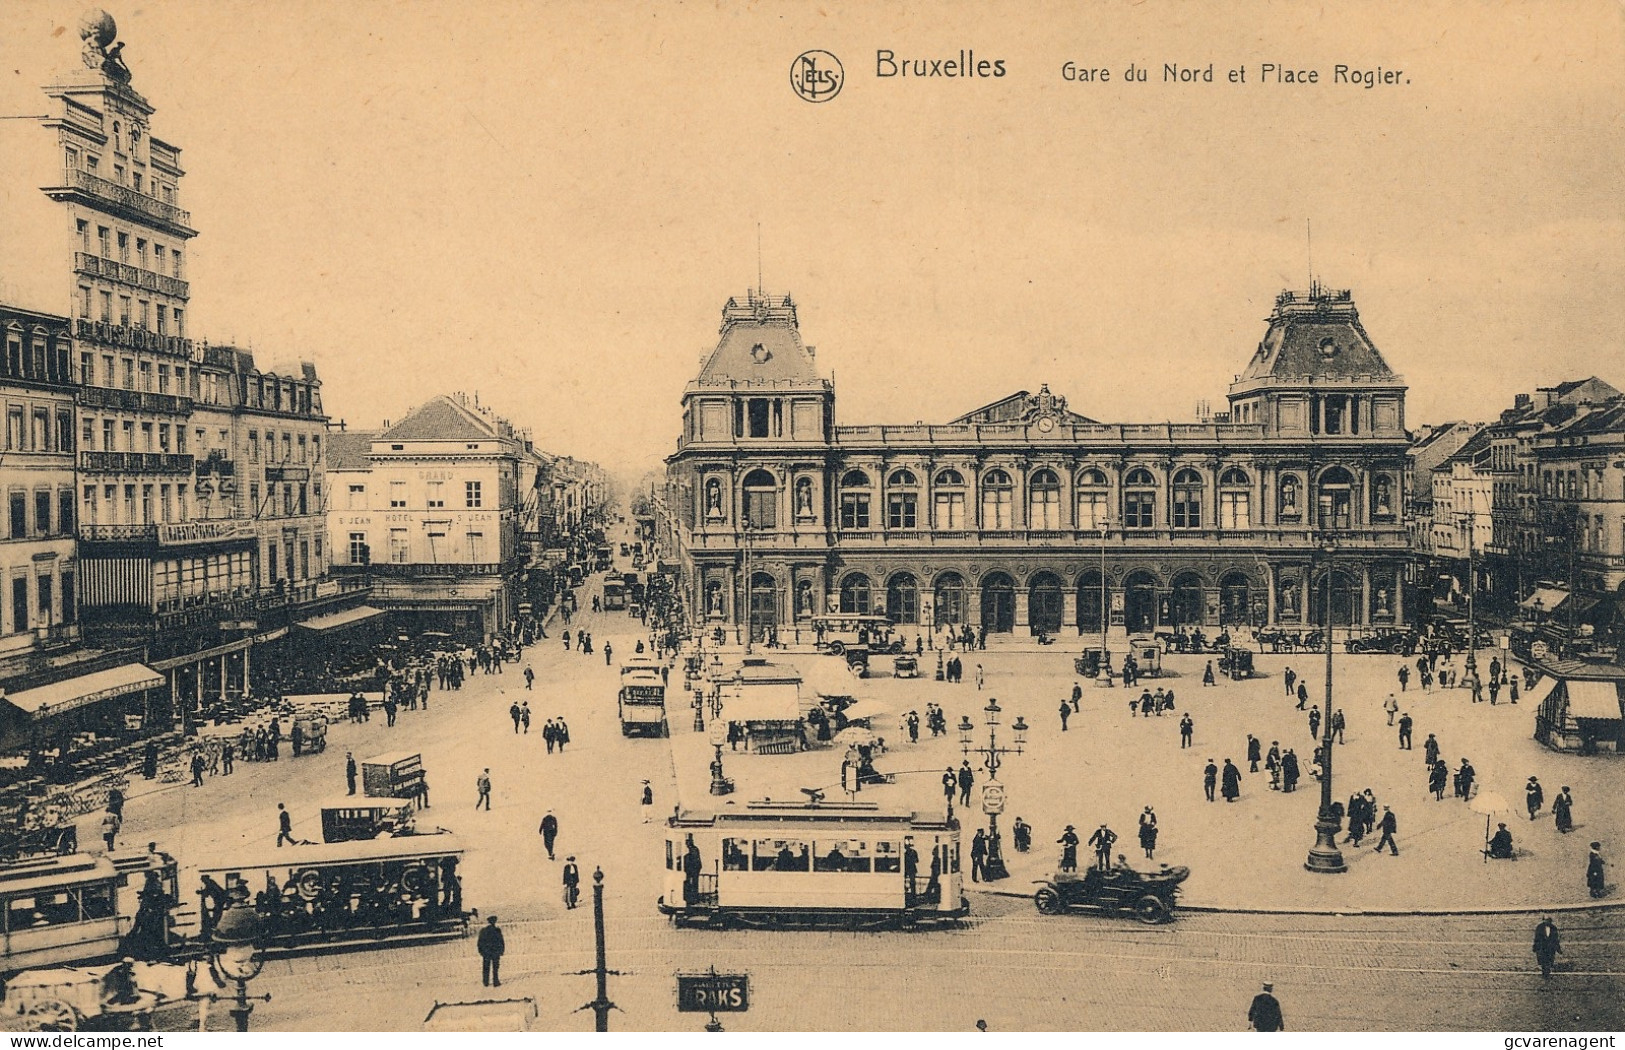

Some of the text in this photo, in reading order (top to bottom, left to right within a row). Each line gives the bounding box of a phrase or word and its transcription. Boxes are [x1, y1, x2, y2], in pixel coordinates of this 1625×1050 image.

[385, 514, 414, 522] HOTEL
[416, 564, 454, 574] HOTEL
[469, 563, 499, 574] JEAN
